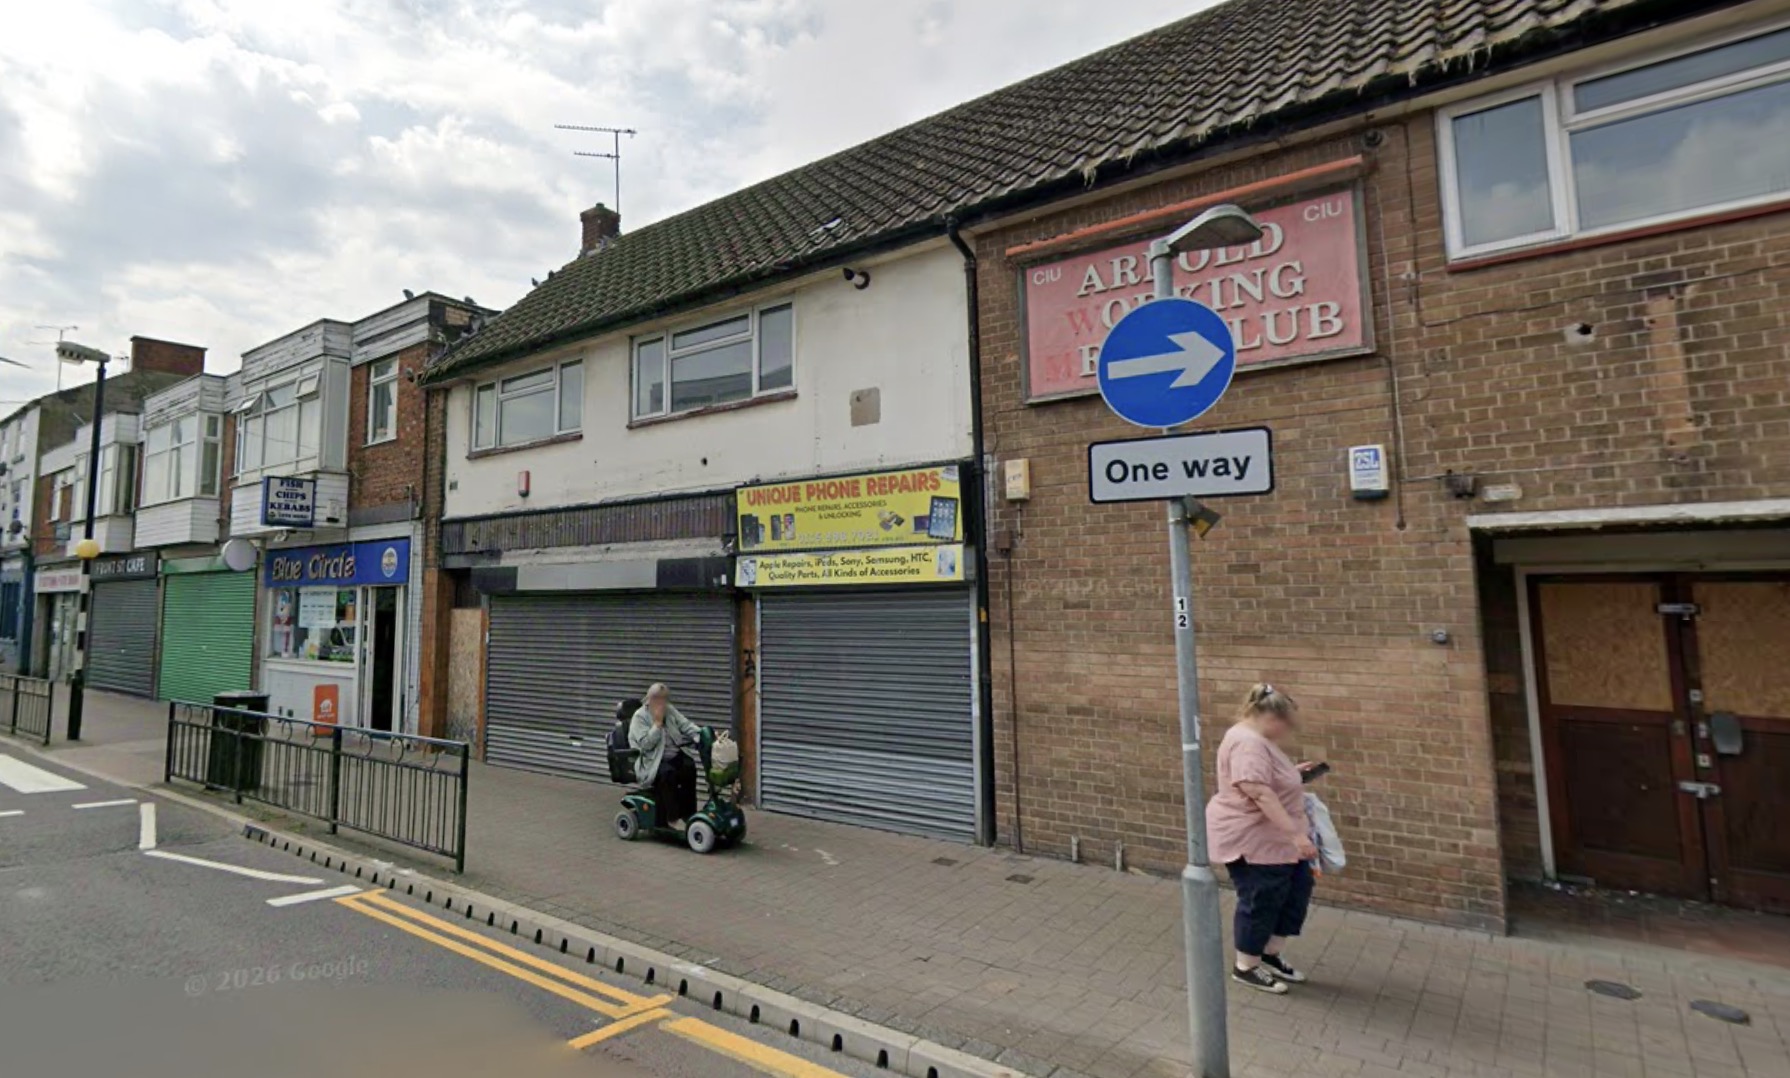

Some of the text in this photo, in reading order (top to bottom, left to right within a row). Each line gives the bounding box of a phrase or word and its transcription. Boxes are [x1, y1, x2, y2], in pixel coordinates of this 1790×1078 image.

[1302, 201, 1343, 222] CIU
[1032, 266, 1062, 285] CIU
[1228, 300, 1344, 351] LUB
[1105, 455, 1251, 484] One way
[275, 491, 306, 500] CHIPS
[747, 470, 941, 507] UNIQUE PHONE REPAIRS
[269, 502, 311, 512] KEBABS
[844, 499, 887, 509] ACCESSORIES
[272, 549, 356, 581] Blue Circle
[759, 560, 781, 570] Apple
[782, 558, 813, 569] Repairs,
[840, 556, 863, 567] Sony,
[865, 555, 909, 566] Samsung,
[911, 552, 932, 563] HTC,
[769, 566, 920, 580] Quality Parts, All Kinds of Accessories
